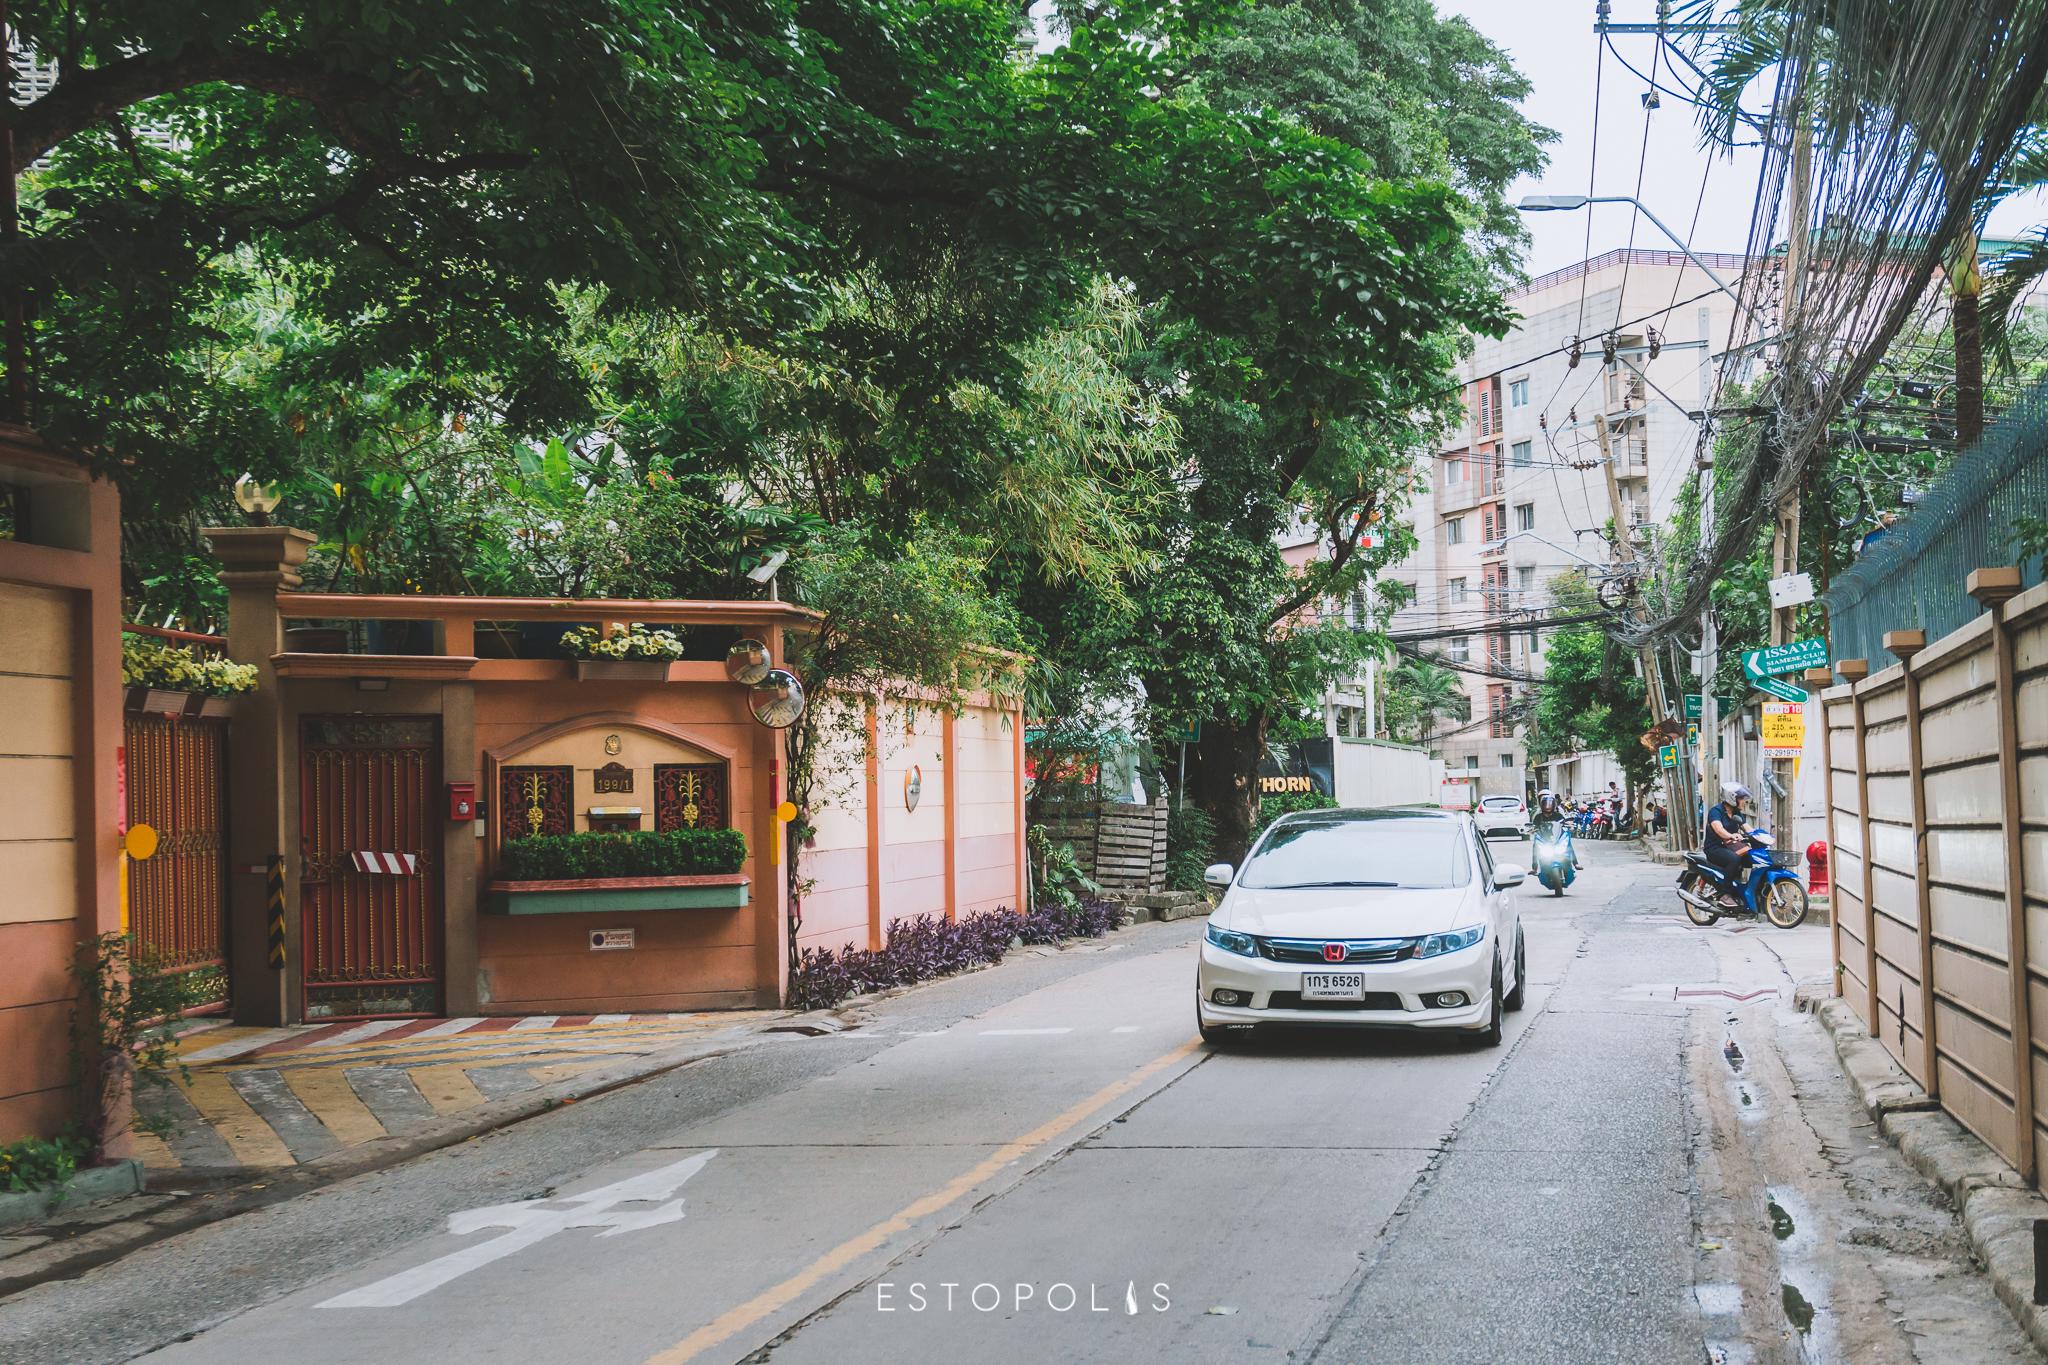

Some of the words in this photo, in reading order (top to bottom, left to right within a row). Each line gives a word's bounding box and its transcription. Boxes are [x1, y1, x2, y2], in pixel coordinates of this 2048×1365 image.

[1765, 640, 1822, 659] ISSAYA
[1766, 655, 1802, 667] SIAMESE
[1803, 650, 1826, 660] CLUB
[1783, 703, 1802, 714] ขาย
[598, 779, 630, 791] 199/1
[1259, 776, 1311, 793] HORN
[1307, 975, 1330, 989] 1กฐ
[1332, 975, 1360, 988] 6526
